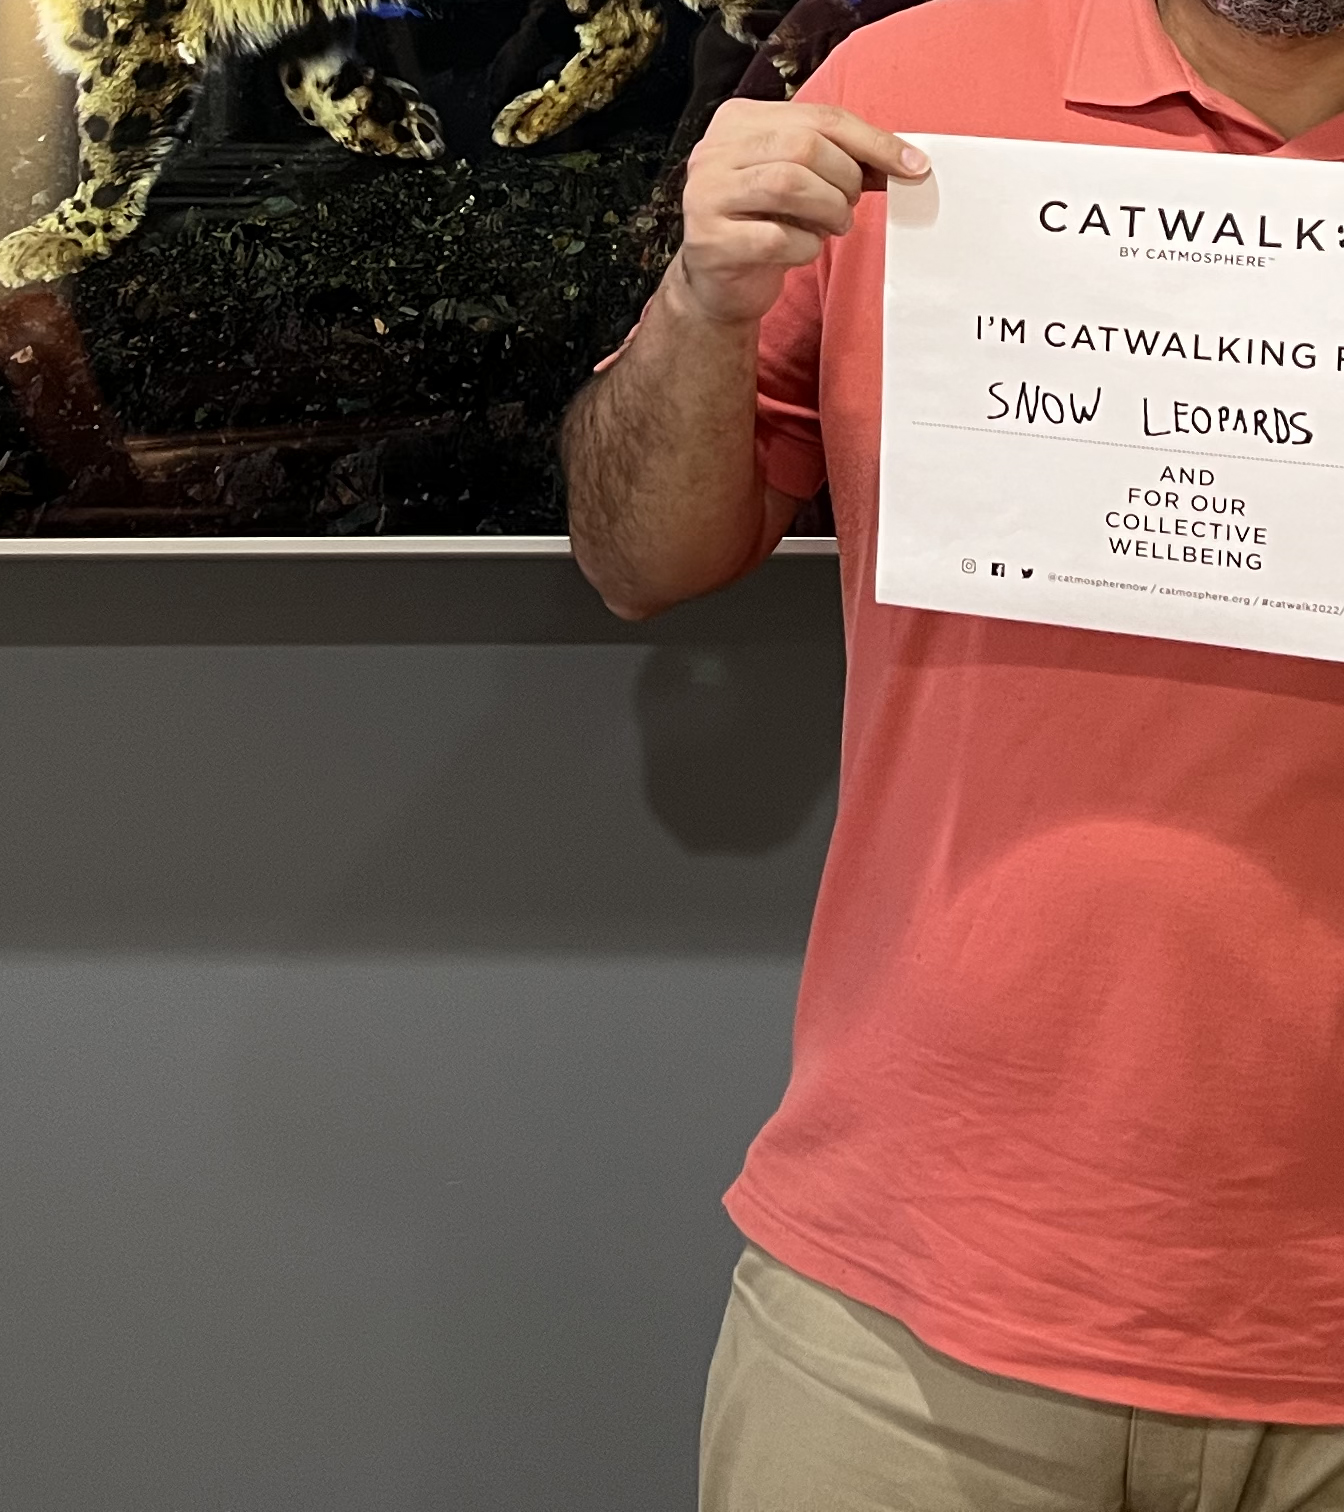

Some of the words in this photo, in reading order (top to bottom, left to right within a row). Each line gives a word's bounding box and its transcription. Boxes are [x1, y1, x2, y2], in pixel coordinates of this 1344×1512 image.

[1039, 200, 1326, 252] CATWALK
[1119, 246, 1140, 258] BY
[1043, 321, 1317, 370] CATWALKING
[986, 380, 1102, 425] SNOW
[1142, 396, 1314, 446] LEOPARDS
[1159, 465, 1215, 487] AND
[1128, 487, 1180, 510] FOR
[1190, 494, 1246, 517] OUR
[1105, 511, 1268, 546] COLLECTIVE
[1108, 536, 1262, 571] WELLBEING
[1047, 572, 1148, 592] @catmospherenow
[1158, 587, 1251, 606] catmosphere.org
